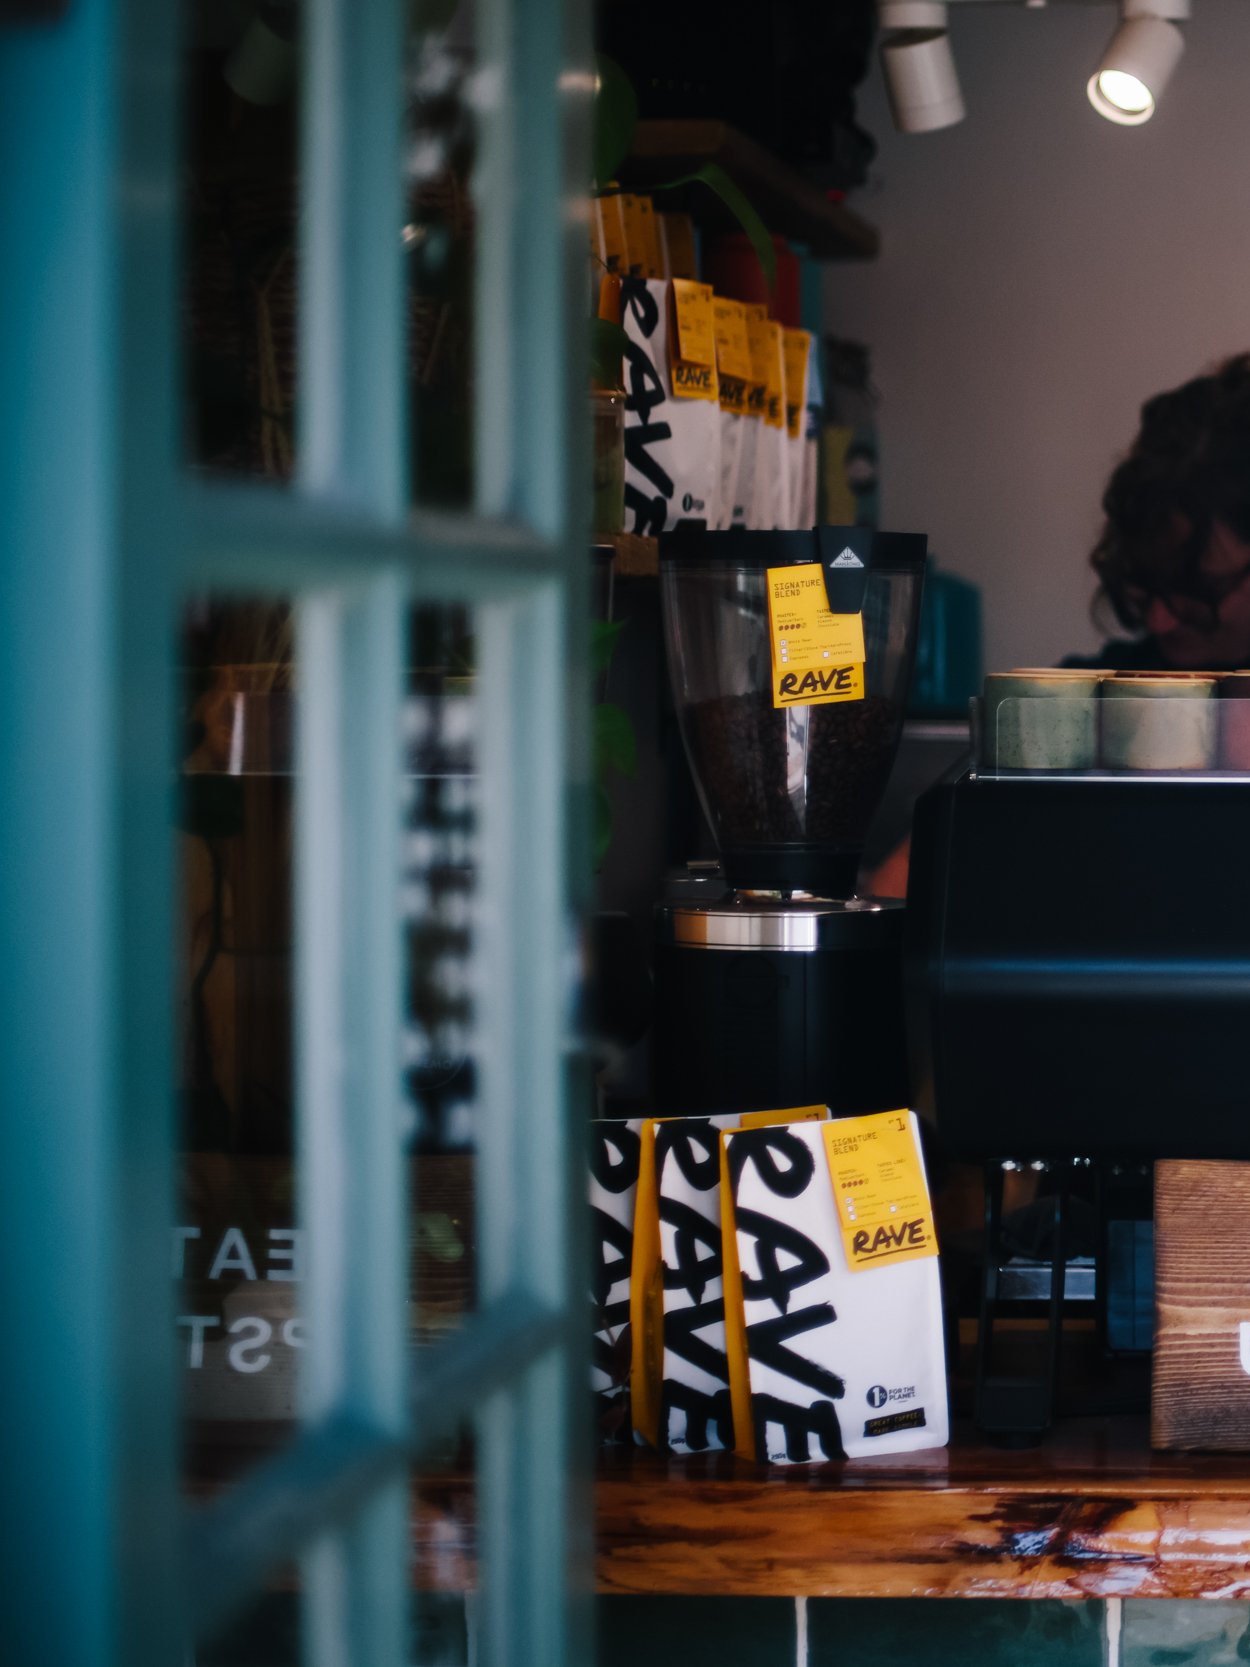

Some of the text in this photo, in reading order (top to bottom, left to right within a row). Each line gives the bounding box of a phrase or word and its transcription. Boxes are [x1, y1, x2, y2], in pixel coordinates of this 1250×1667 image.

[774, 579, 821, 591] SIGNATURE
[774, 589, 801, 598] BLEND
[832, 1131, 878, 1147] SIGNATURE
[833, 1144, 859, 1155] BLEND
